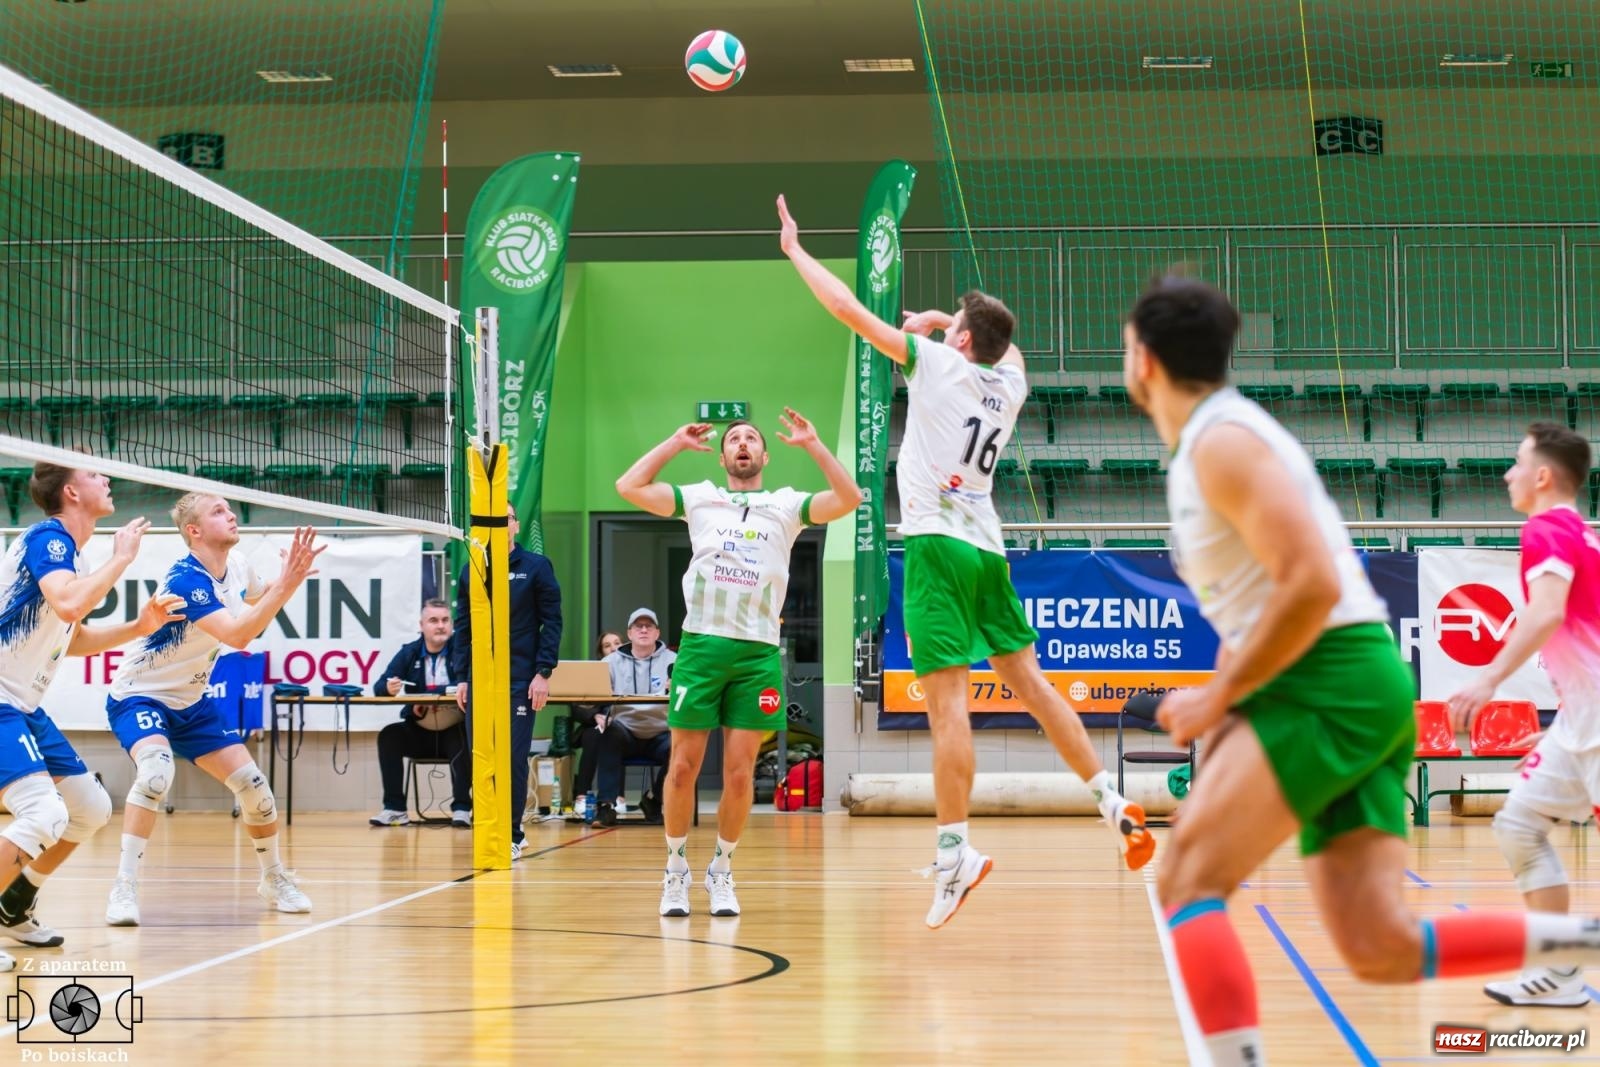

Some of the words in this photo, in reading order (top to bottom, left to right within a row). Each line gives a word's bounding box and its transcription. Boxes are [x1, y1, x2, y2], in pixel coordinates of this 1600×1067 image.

[1320, 130, 1343, 151] C
[1358, 130, 1378, 150] C
[192, 145, 216, 165] B
[484, 218, 508, 248] KLUB
[506, 212, 558, 252] SIATKARSKI
[490, 267, 549, 289] RACIBÓRZ
[961, 416, 1003, 476] 16
[857, 487, 874, 552] KLUB
[716, 528, 769, 541] VISON
[714, 565, 760, 581] PIVEXIN
[714, 575, 758, 587] TECHNOLOGY
[1047, 639, 1148, 664] Opawska
[1153, 639, 1182, 659] 55
[674, 685, 688, 712] 7
[971, 683, 996, 700] 77
